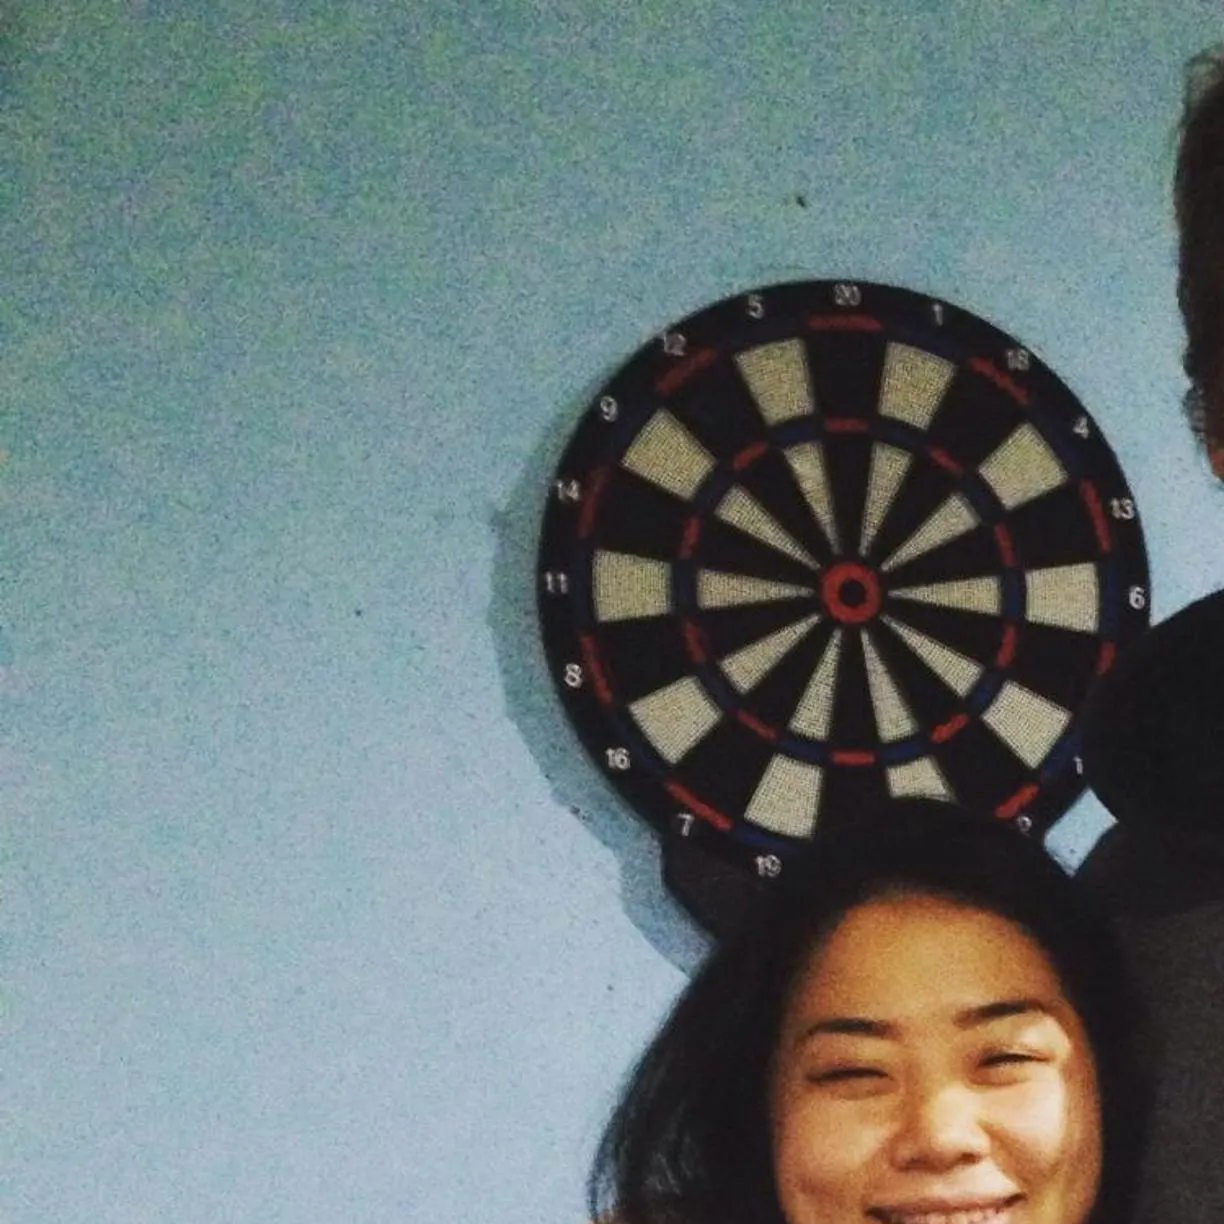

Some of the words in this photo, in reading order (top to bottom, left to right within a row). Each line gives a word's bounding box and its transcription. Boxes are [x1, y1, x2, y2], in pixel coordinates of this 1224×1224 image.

[747, 294, 764, 319] 5
[834, 284, 862, 306] 20
[932, 303, 943, 325] 1
[600, 396, 618, 421] 9
[1072, 416, 1089, 439] 4
[556, 479, 580, 500] 14
[1110, 497, 1134, 520] 13
[545, 571, 567, 593] 11
[1128, 586, 1146, 609] 6
[564, 663, 583, 688] 8
[605, 747, 631, 770] 16
[677, 812, 694, 837] 7
